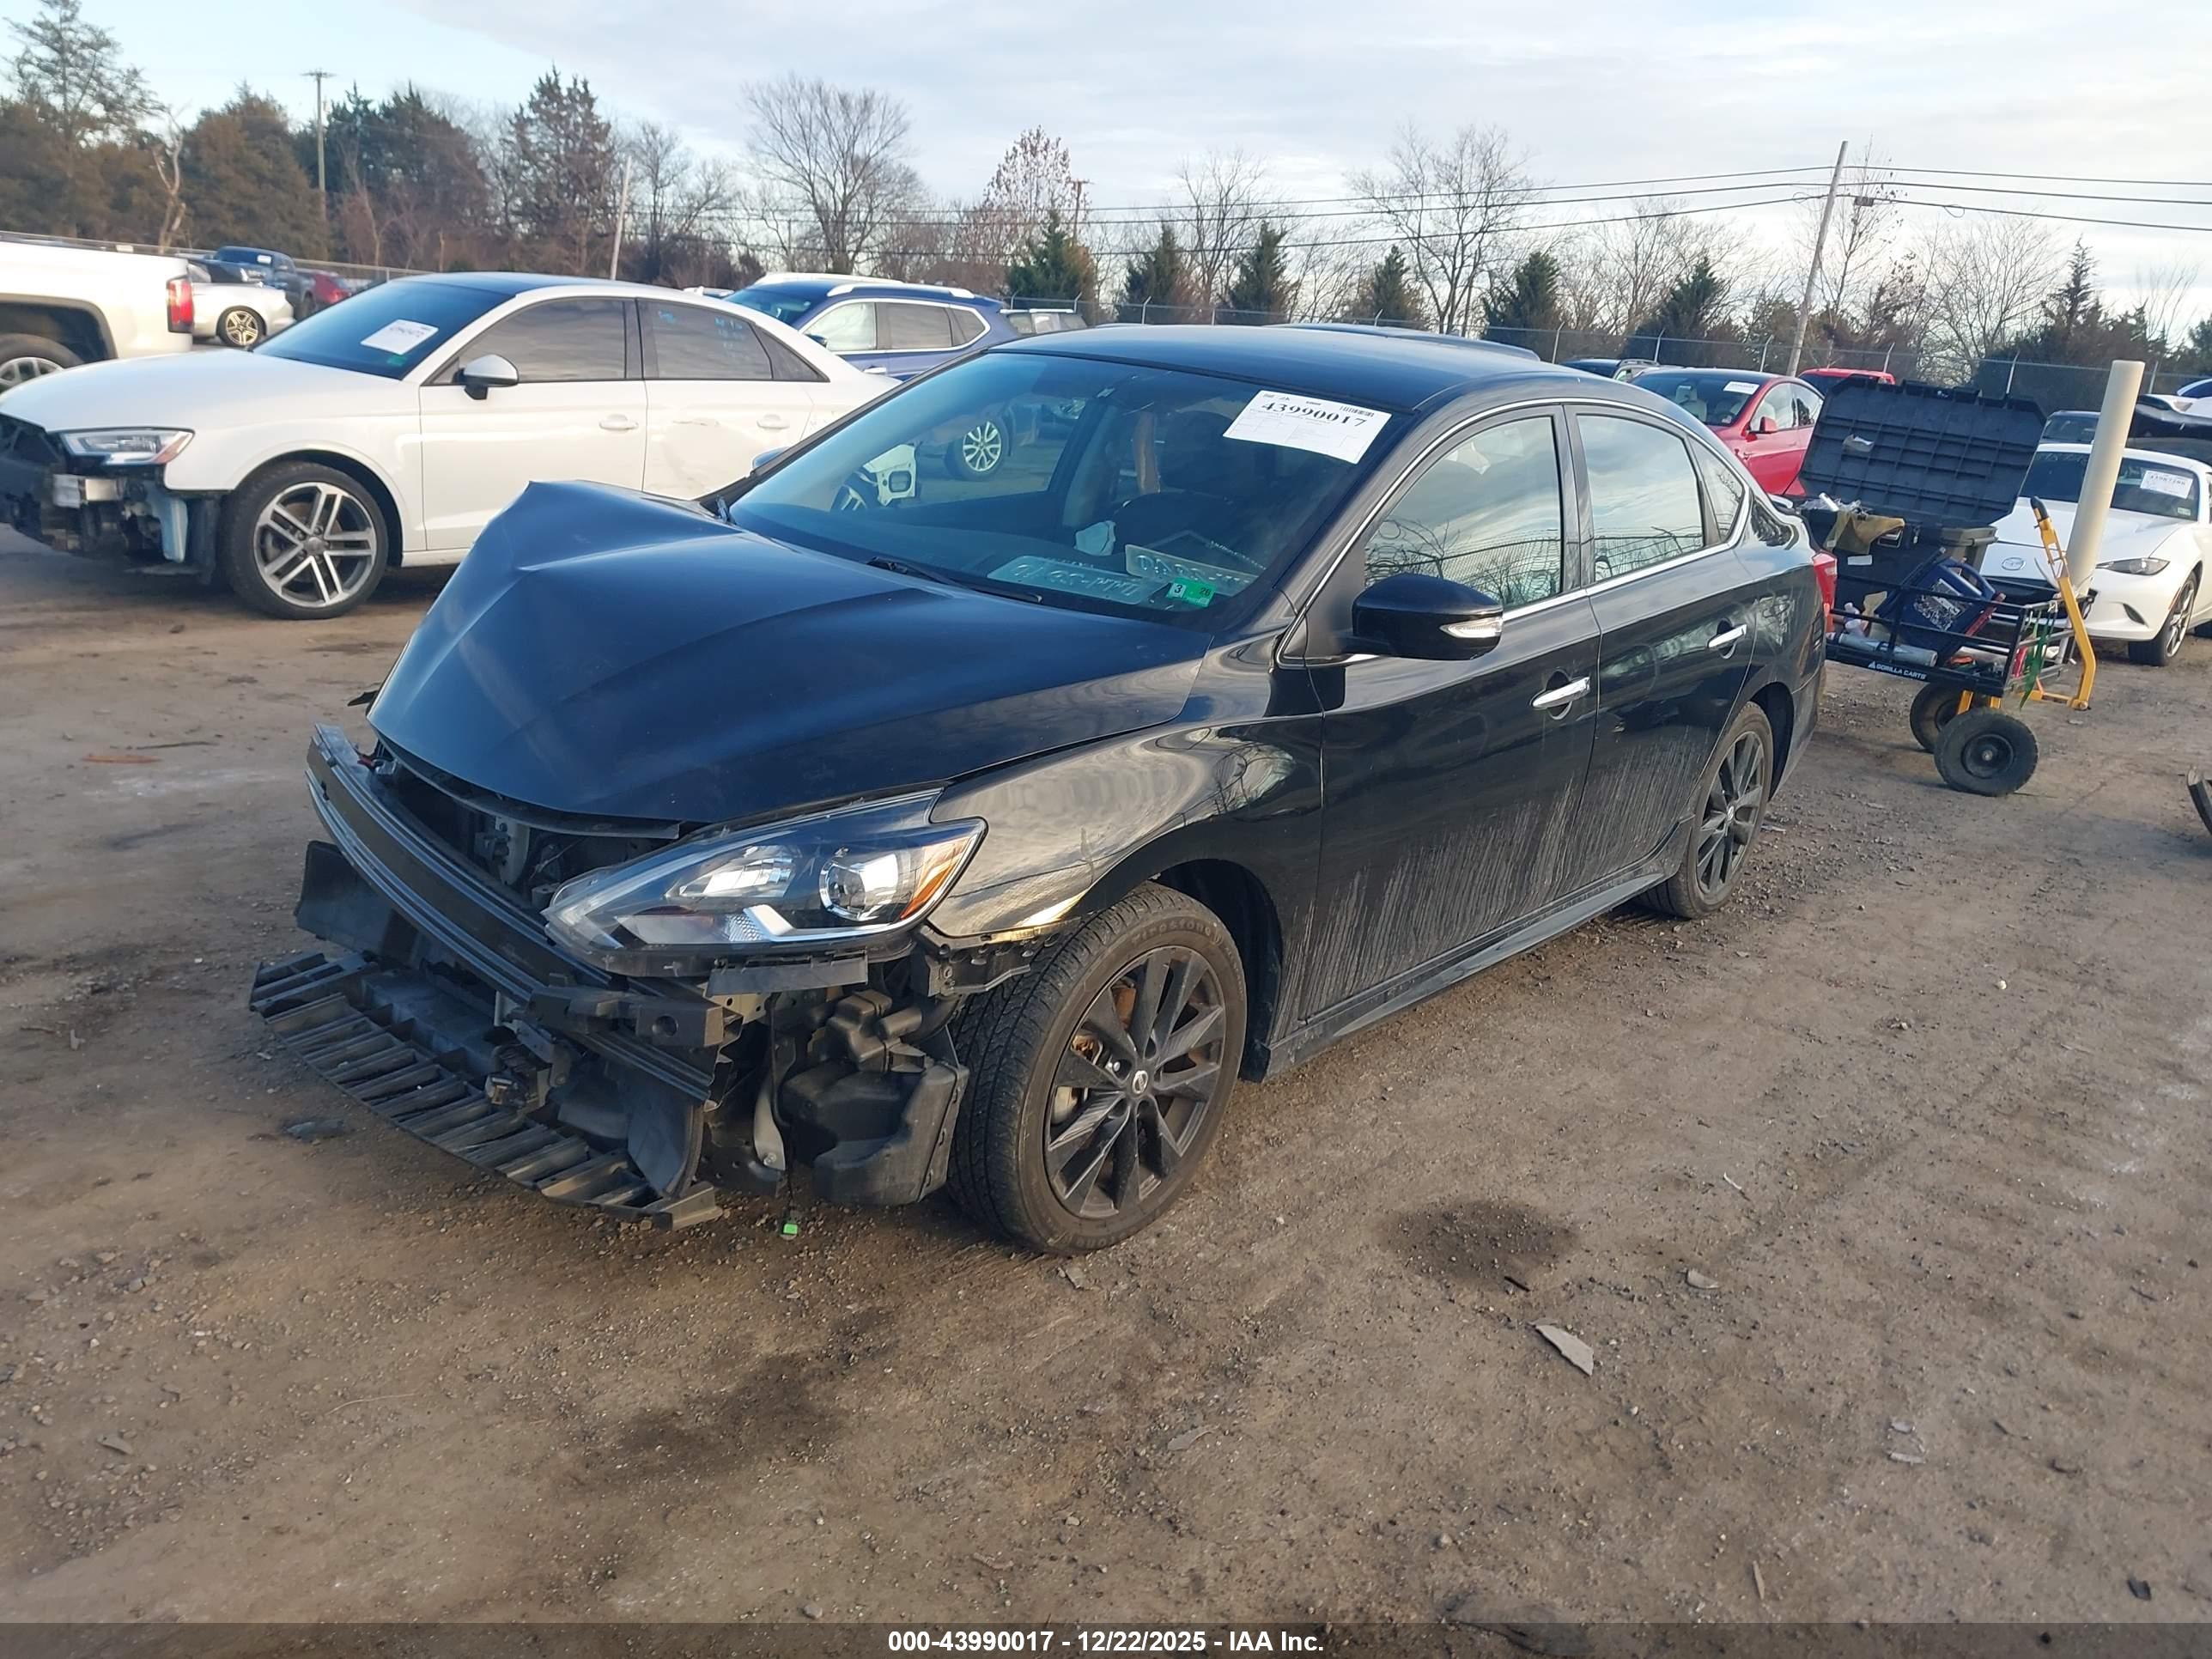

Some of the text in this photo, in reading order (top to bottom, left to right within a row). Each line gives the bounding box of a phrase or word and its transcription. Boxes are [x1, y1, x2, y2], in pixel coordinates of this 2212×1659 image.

[1261, 402, 1368, 427] 43990017
[1174, 584, 1183, 593] 3
[1875, 663, 1903, 674] GORILLA
